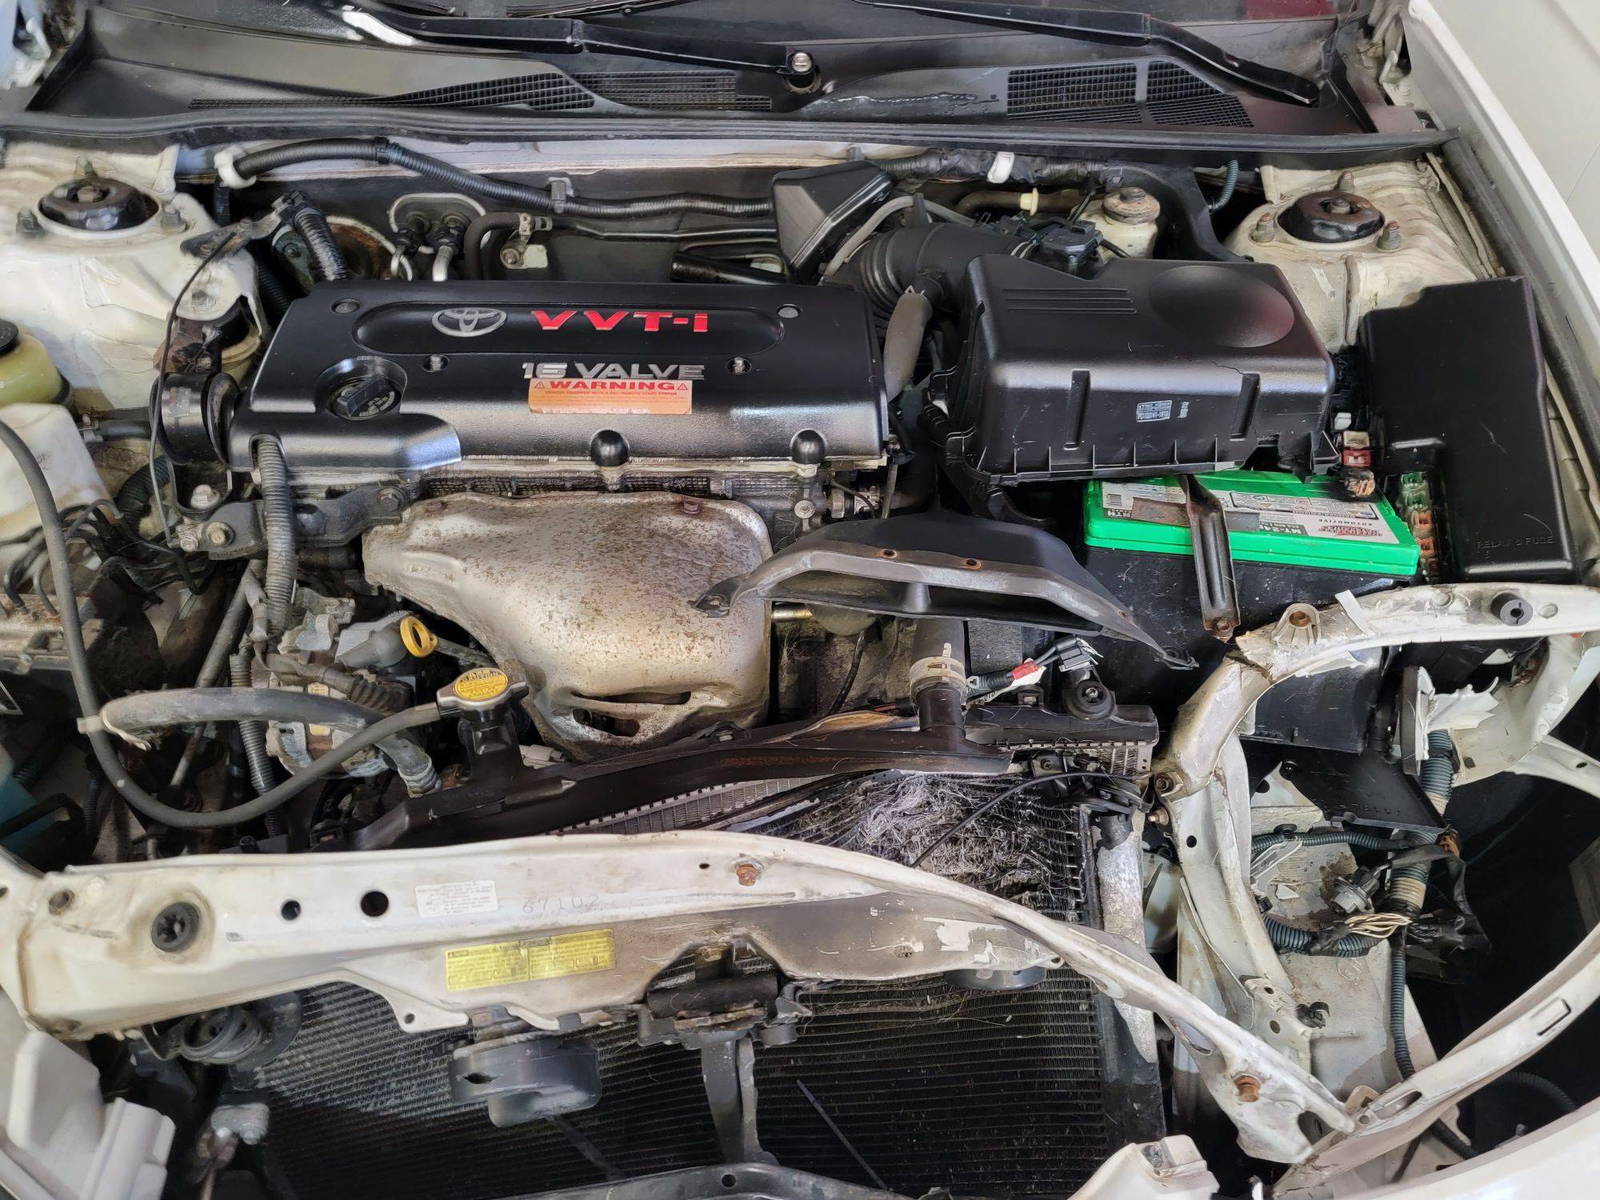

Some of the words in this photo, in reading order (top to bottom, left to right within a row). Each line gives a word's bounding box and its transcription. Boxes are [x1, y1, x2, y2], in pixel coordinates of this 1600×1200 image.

[531, 310, 709, 333] VVT-i
[522, 362, 568, 380] 16
[574, 363, 705, 381] VALVE
[549, 381, 676, 391] WARNING
